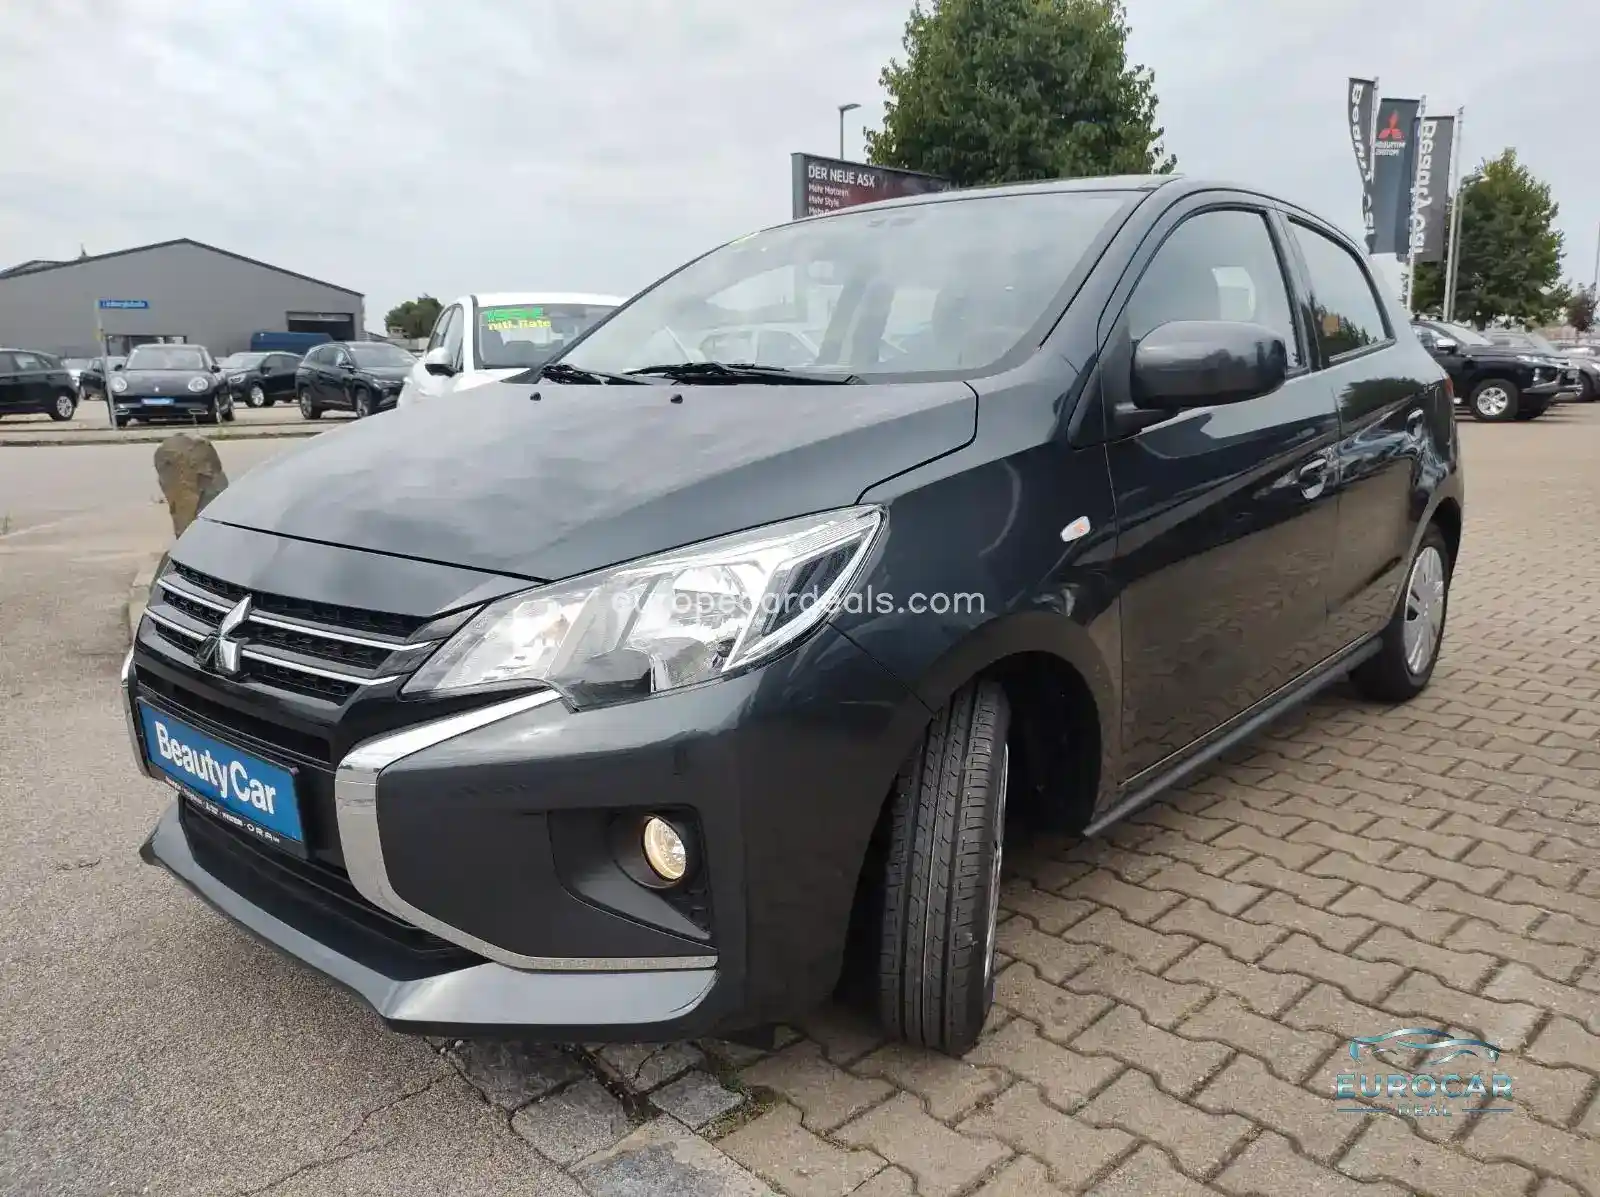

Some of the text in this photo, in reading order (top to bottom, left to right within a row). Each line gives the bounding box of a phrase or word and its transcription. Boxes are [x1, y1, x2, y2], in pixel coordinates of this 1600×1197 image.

[808, 165, 876, 189] DER NEUE ASX
[155, 721, 276, 815] BeautyCar
